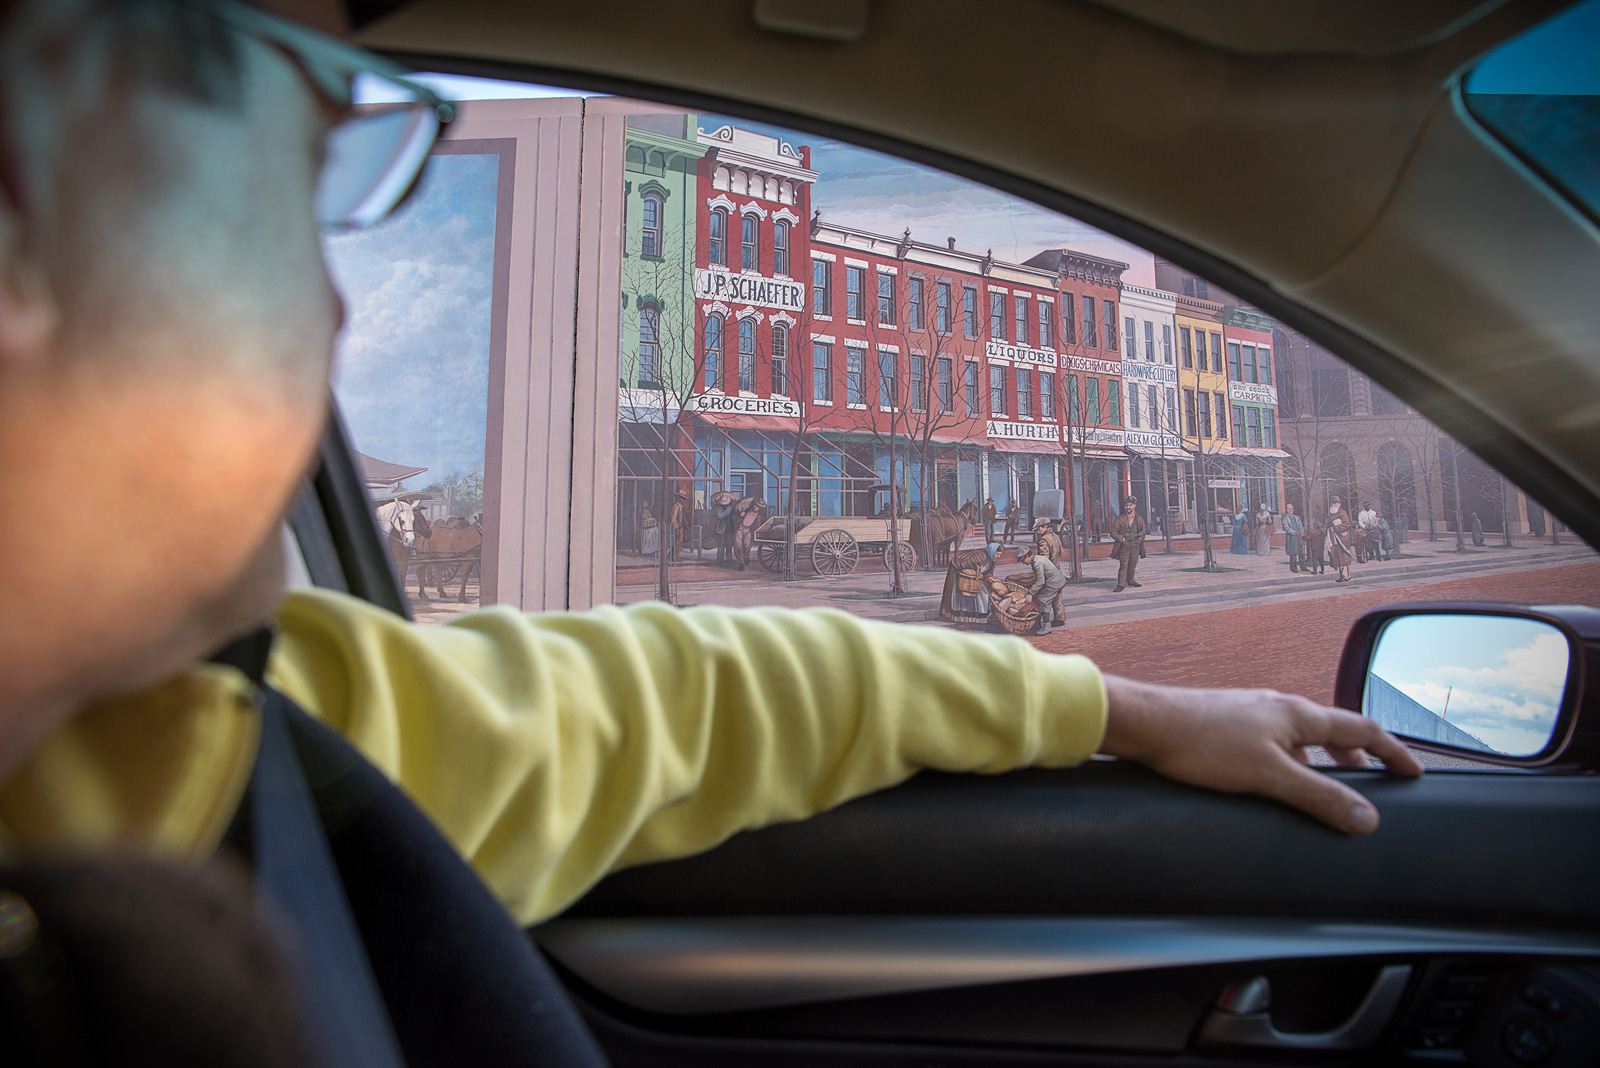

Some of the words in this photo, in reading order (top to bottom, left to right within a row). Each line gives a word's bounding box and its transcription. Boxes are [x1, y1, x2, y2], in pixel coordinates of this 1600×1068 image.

[730, 276, 799, 307] SCHAEFER
[988, 344, 1054, 364] LIQUORS
[698, 396, 798, 415] GROCERIES.
[1233, 391, 1272, 402] CARPETS
